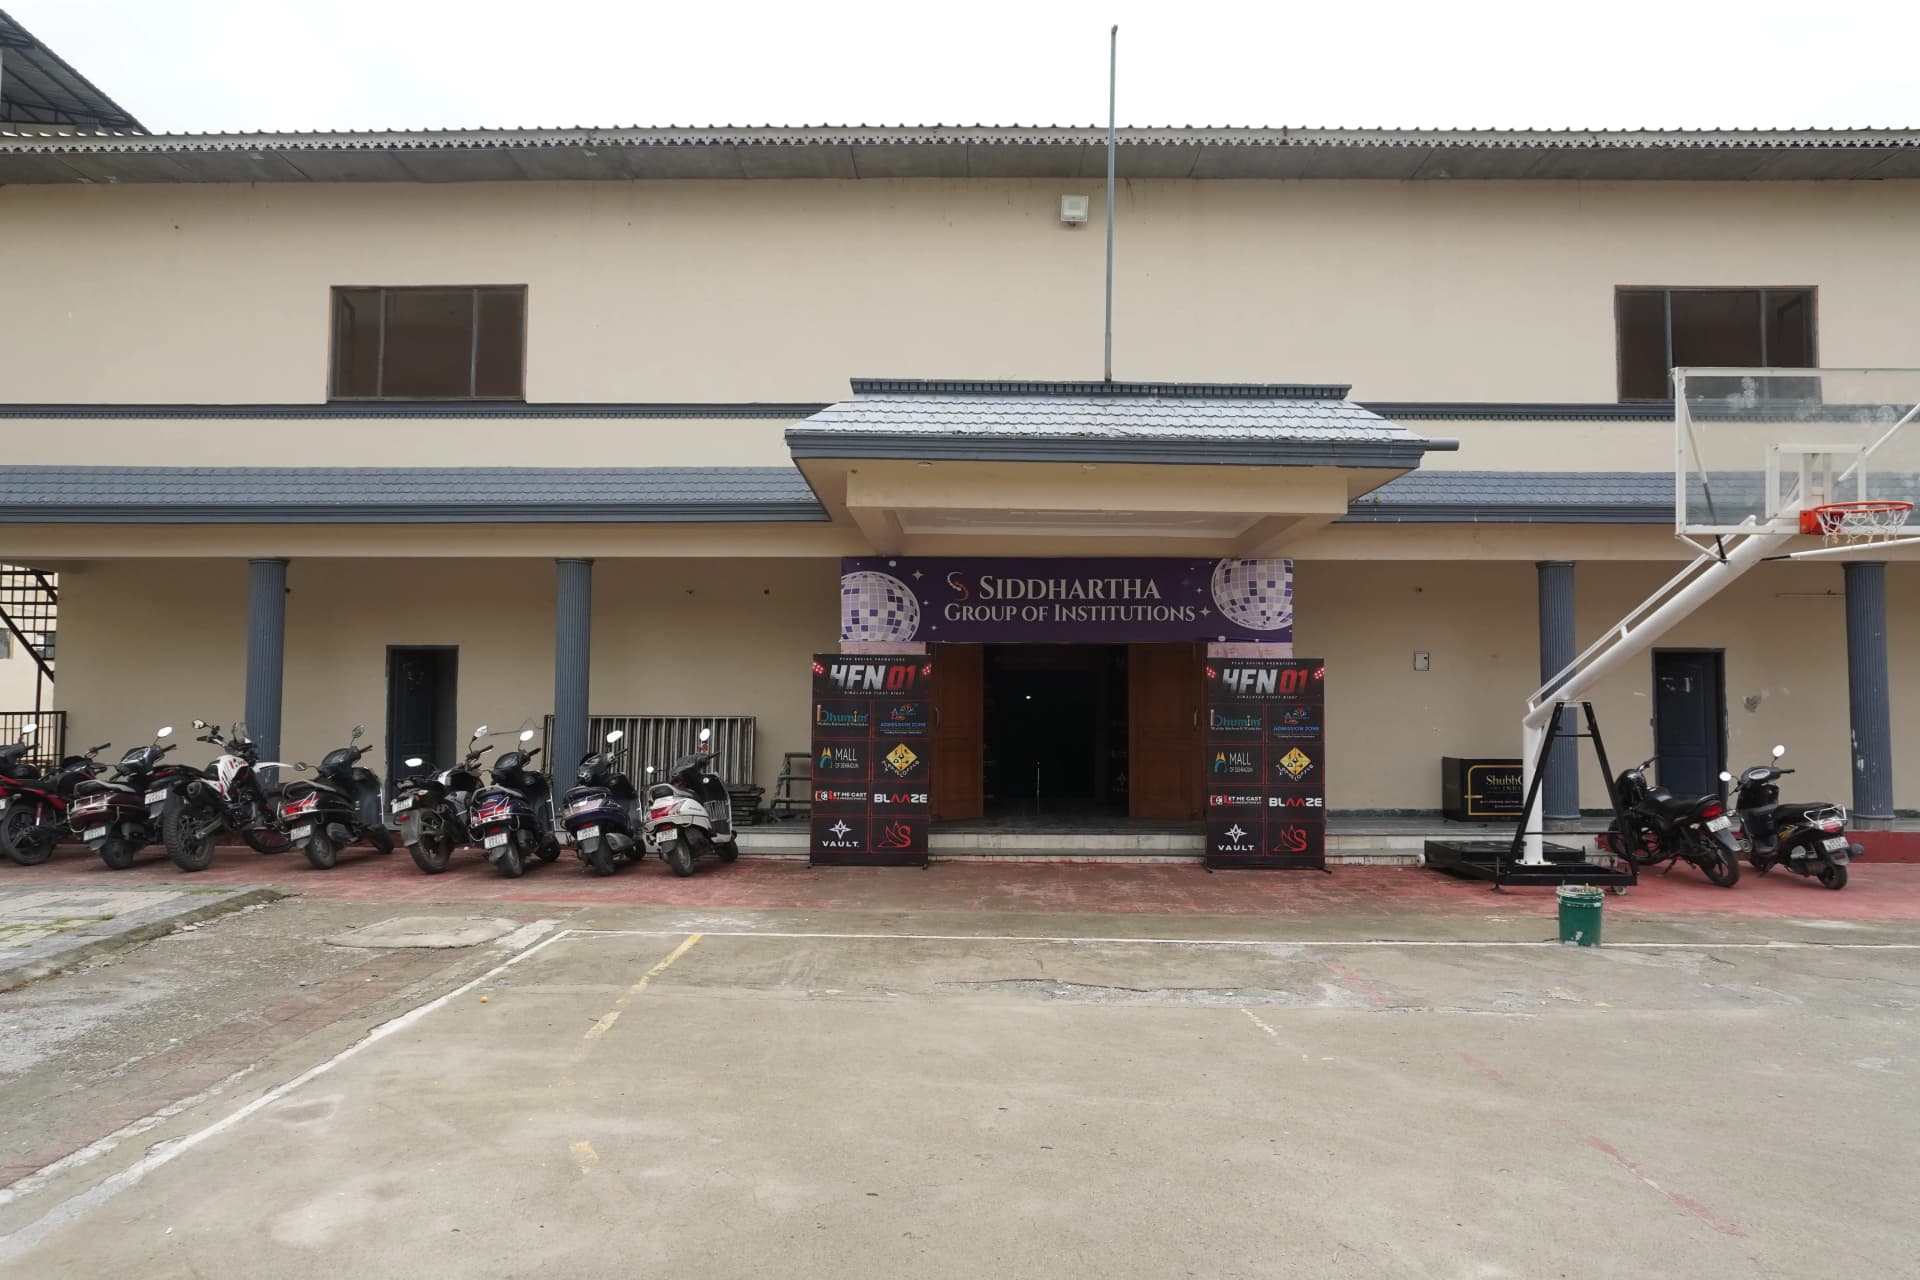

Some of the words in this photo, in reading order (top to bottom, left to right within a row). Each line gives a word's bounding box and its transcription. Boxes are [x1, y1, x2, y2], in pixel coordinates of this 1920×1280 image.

[979, 575, 1161, 600] SIDDHARTHA
[944, 603, 1017, 623] GROUP
[1021, 604, 1048, 622] OF
[1054, 603, 1196, 623] INSTITUTIONS
[886, 665, 917, 690] 01
[1279, 669, 1309, 694] 01
[835, 747, 857, 761] MALL
[1229, 751, 1252, 765] MALL
